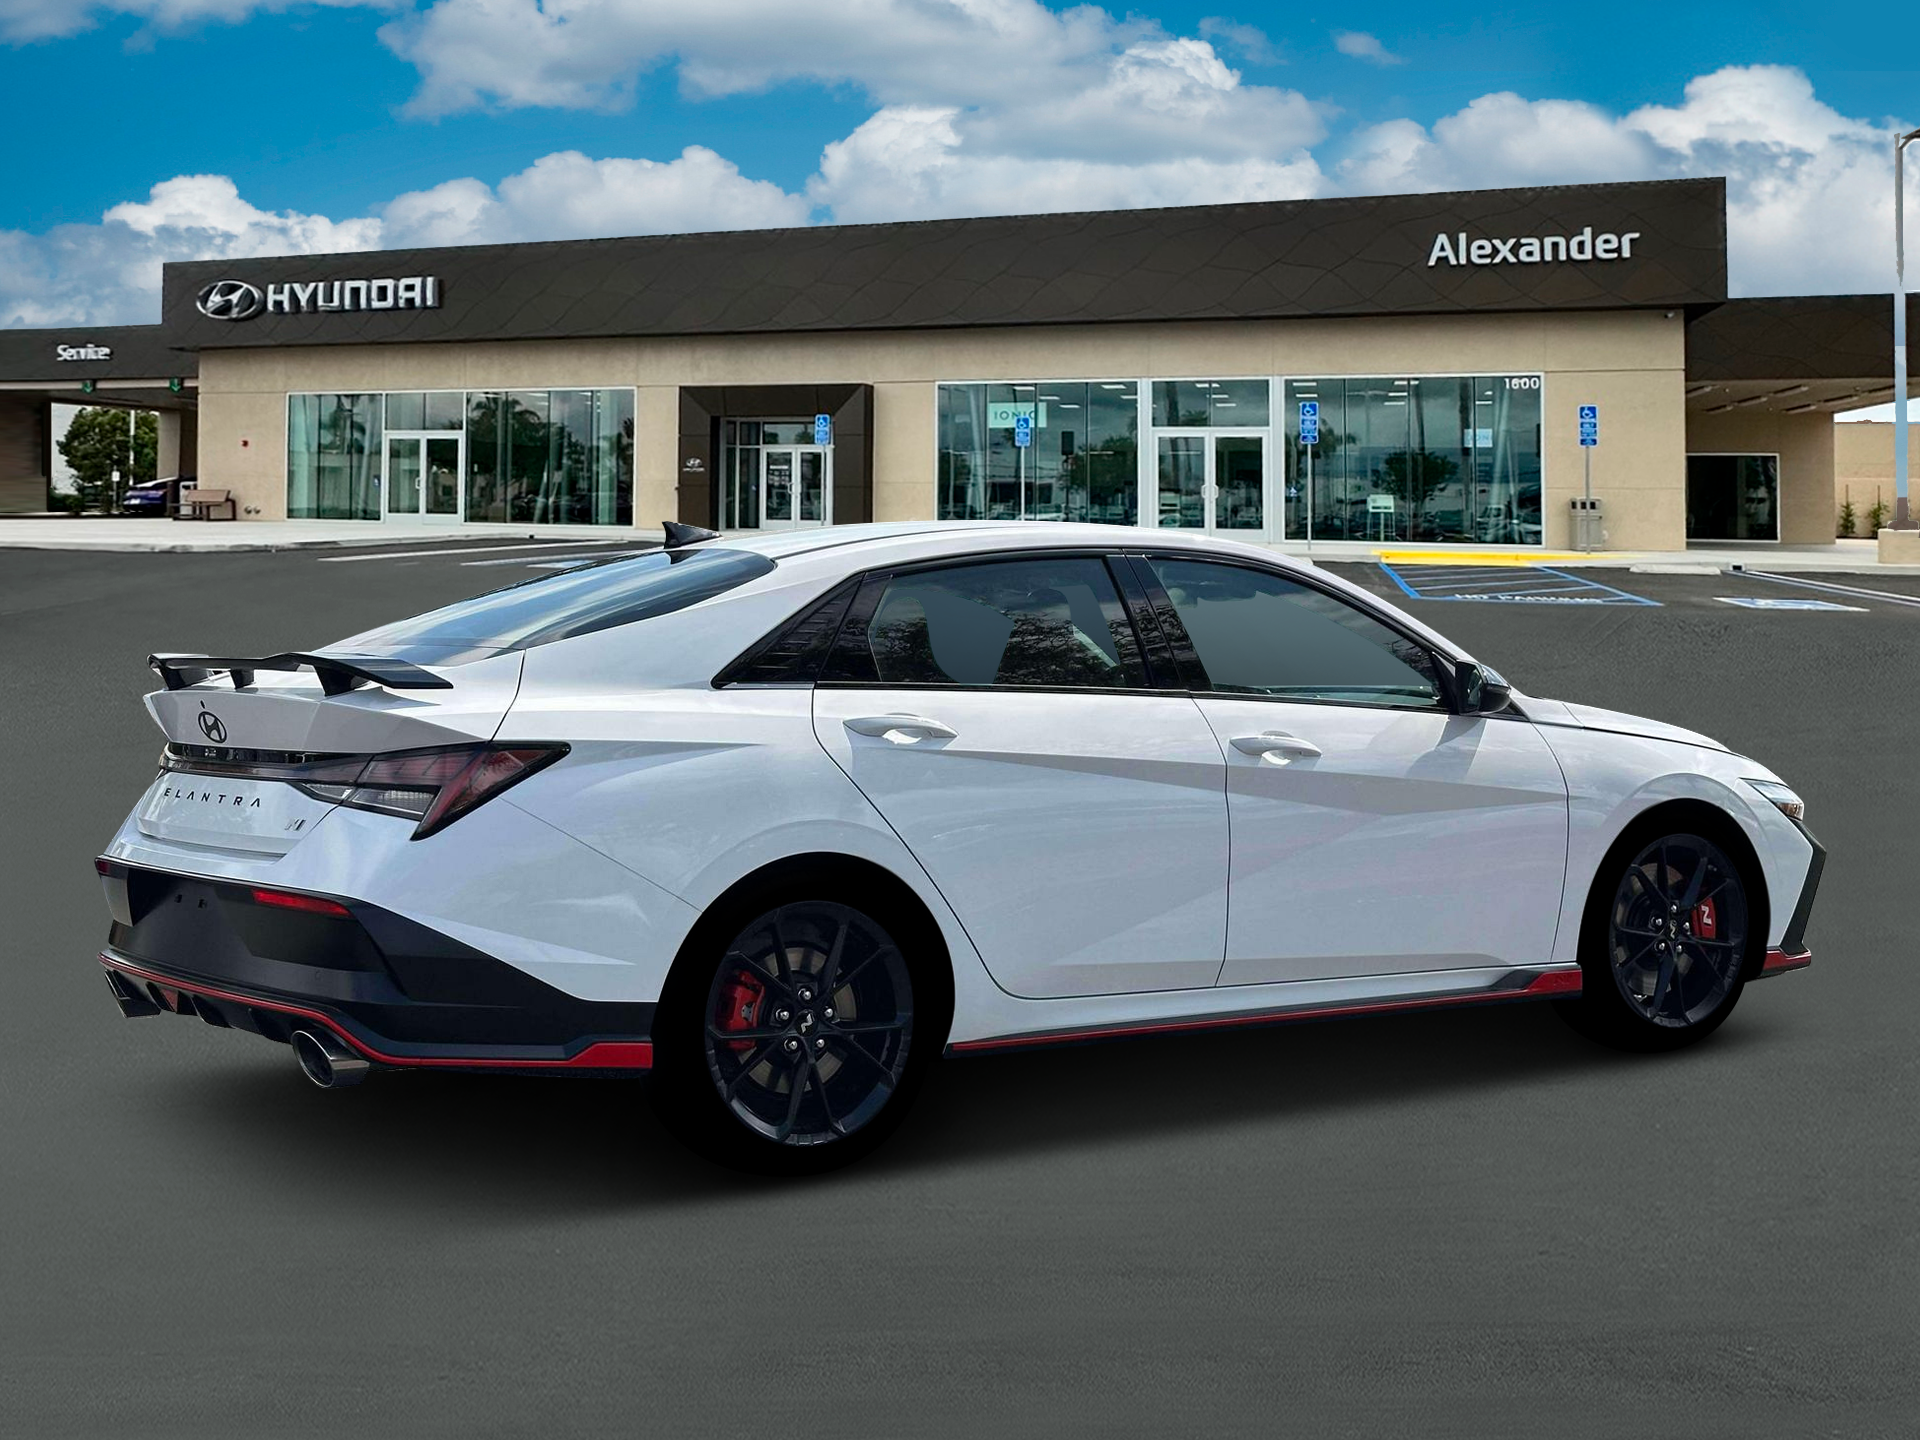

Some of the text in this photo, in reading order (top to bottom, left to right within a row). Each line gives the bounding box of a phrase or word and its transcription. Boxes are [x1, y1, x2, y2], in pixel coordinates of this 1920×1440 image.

[1427, 226, 1641, 267] Alexander
[266, 276, 440, 315] HYUNDAI
[56, 343, 111, 361] Service
[1504, 377, 1541, 390] 1600
[163, 787, 261, 808] ELANTRA
